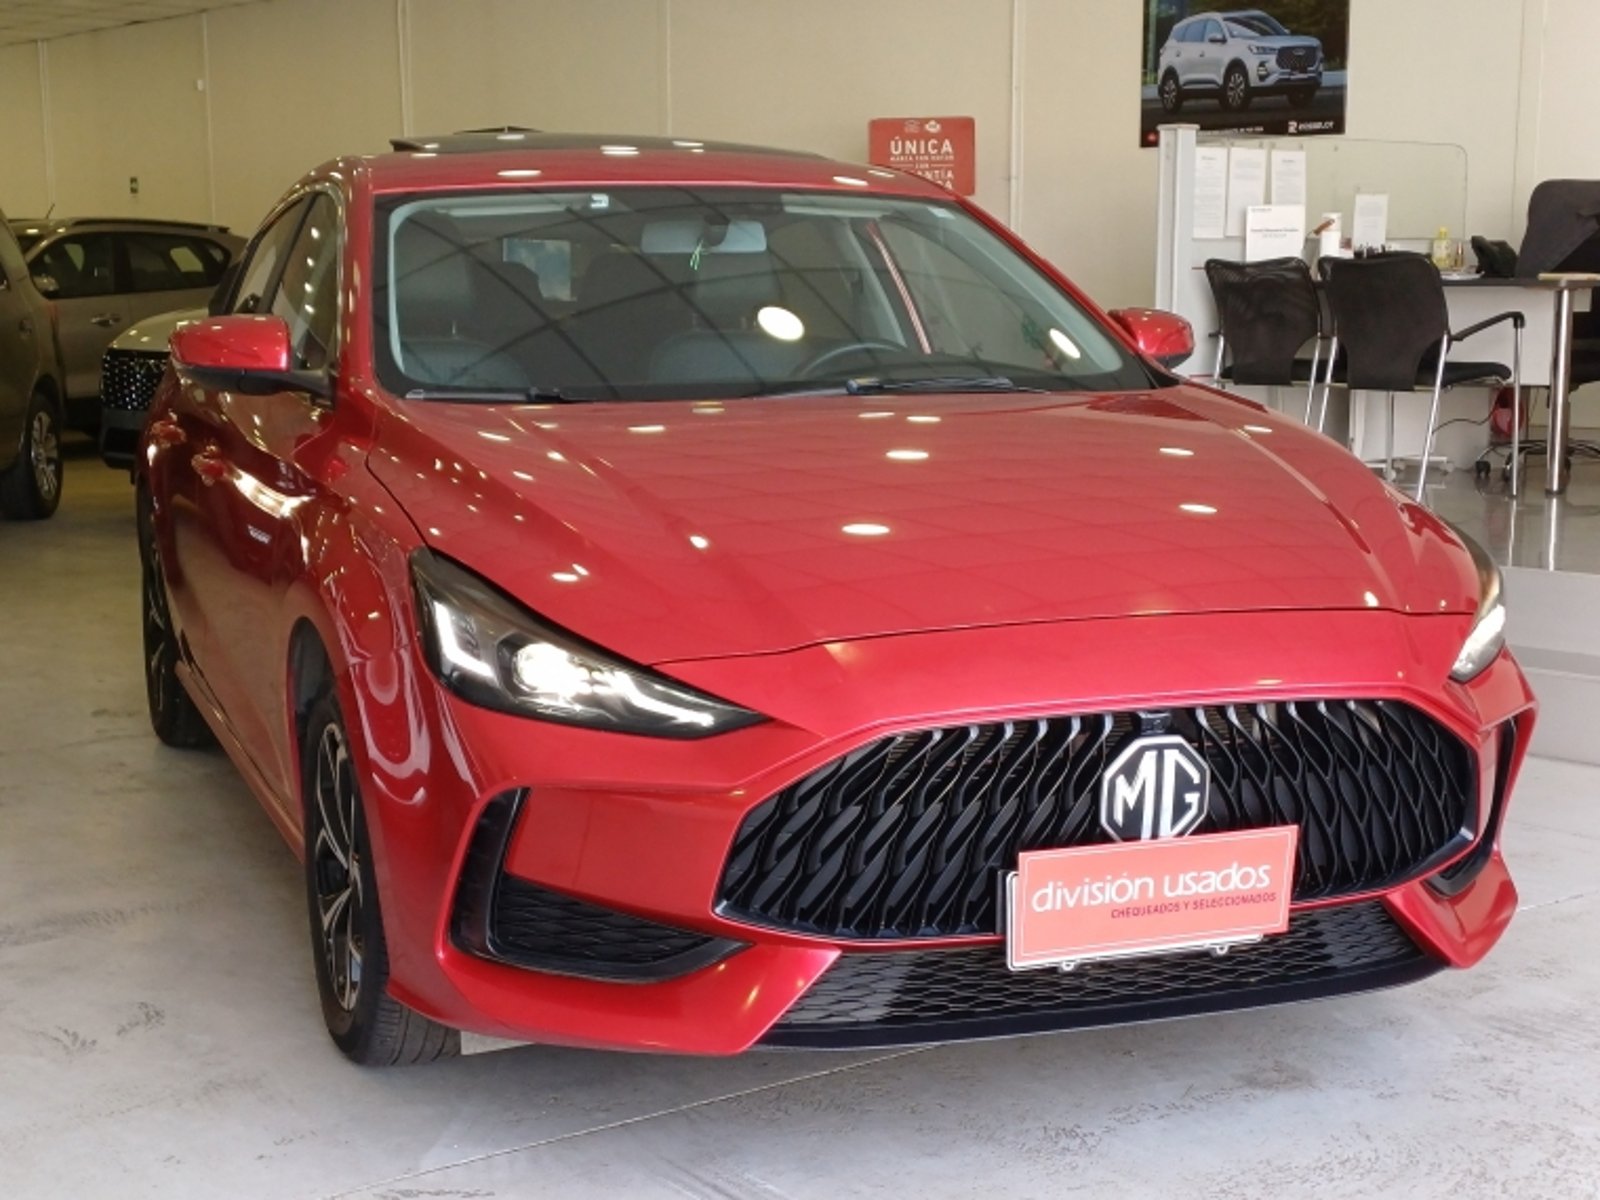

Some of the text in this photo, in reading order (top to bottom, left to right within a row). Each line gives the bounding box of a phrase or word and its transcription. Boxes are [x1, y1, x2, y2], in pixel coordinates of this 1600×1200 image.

[890, 136, 953, 155] ÚNICA
[1113, 748, 1201, 841] MG
[1031, 860, 1272, 913] división usados
[1110, 892, 1277, 919] CHEQUEADOS Y SELECCIONADOS
